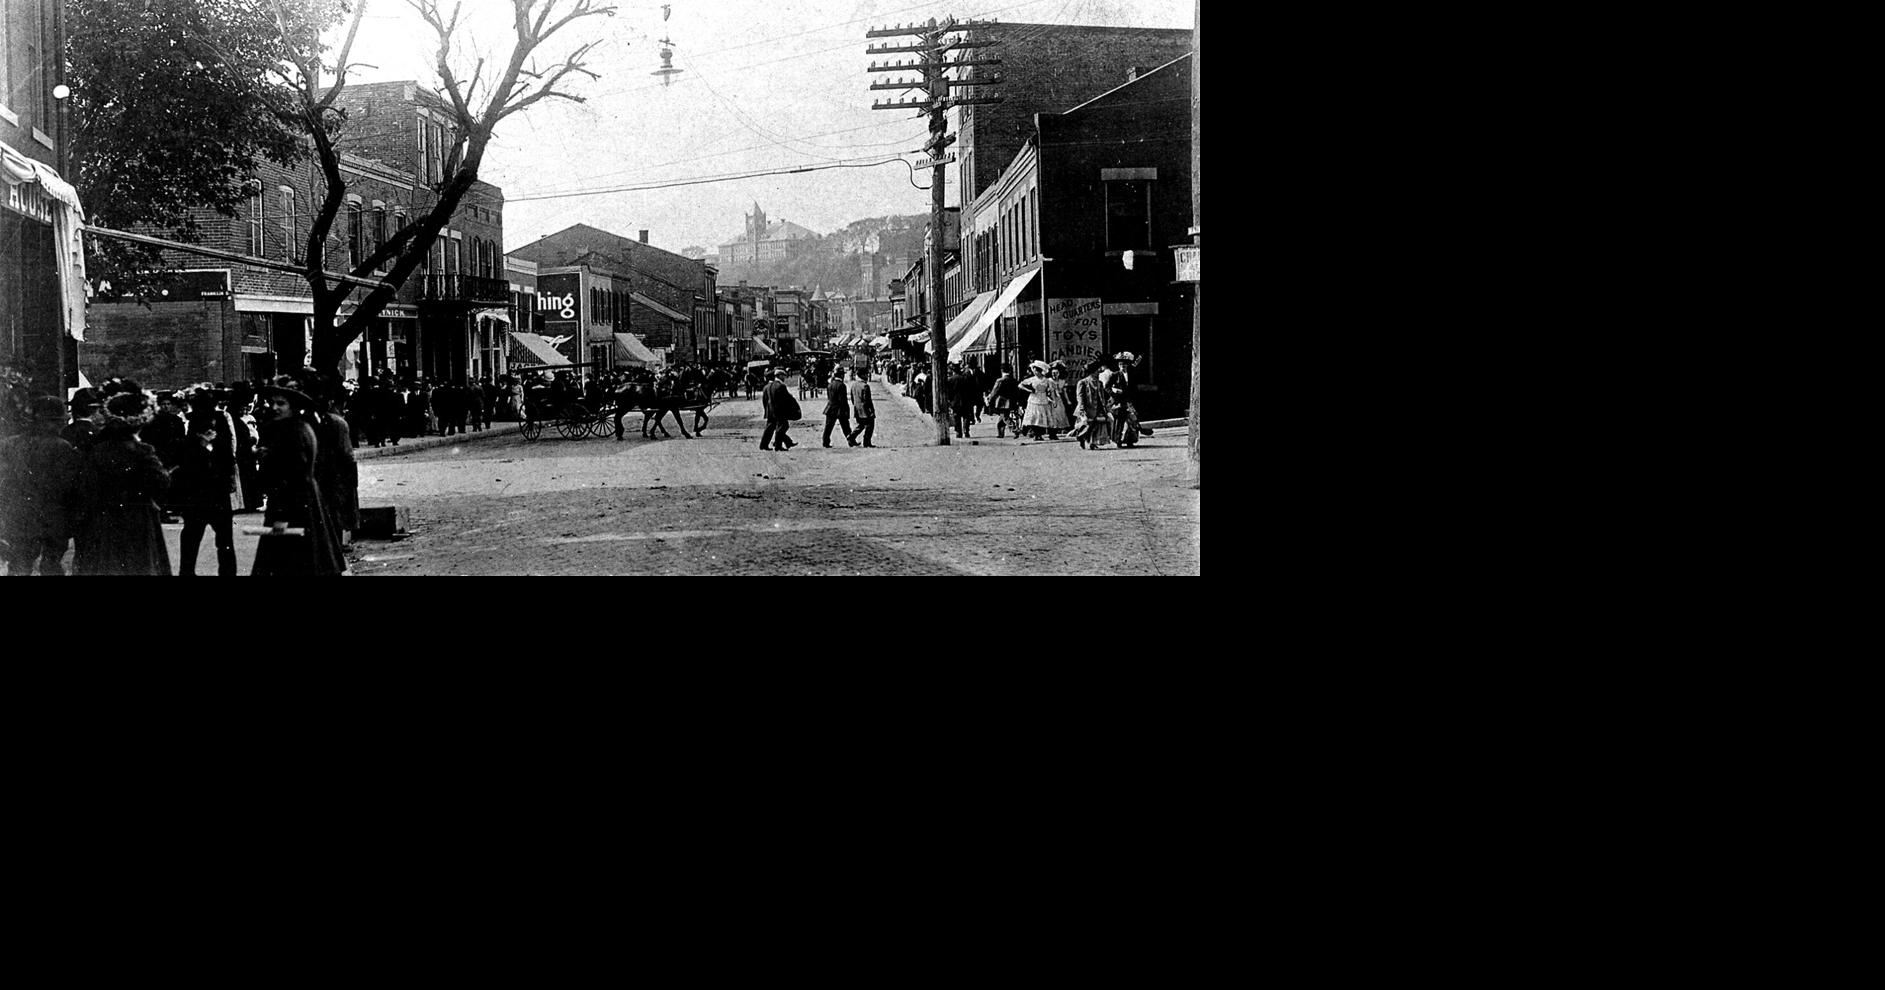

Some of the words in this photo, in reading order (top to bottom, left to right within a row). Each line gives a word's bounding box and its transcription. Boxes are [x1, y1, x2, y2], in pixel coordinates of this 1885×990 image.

[536, 291, 576, 320] hing
[1049, 300, 1074, 315] HEAD
[1062, 301, 1101, 320] QUARTERS
[1074, 318, 1098, 327] FOR
[1052, 330, 1098, 341] TOYS
[1051, 345, 1102, 361] CANDIES
